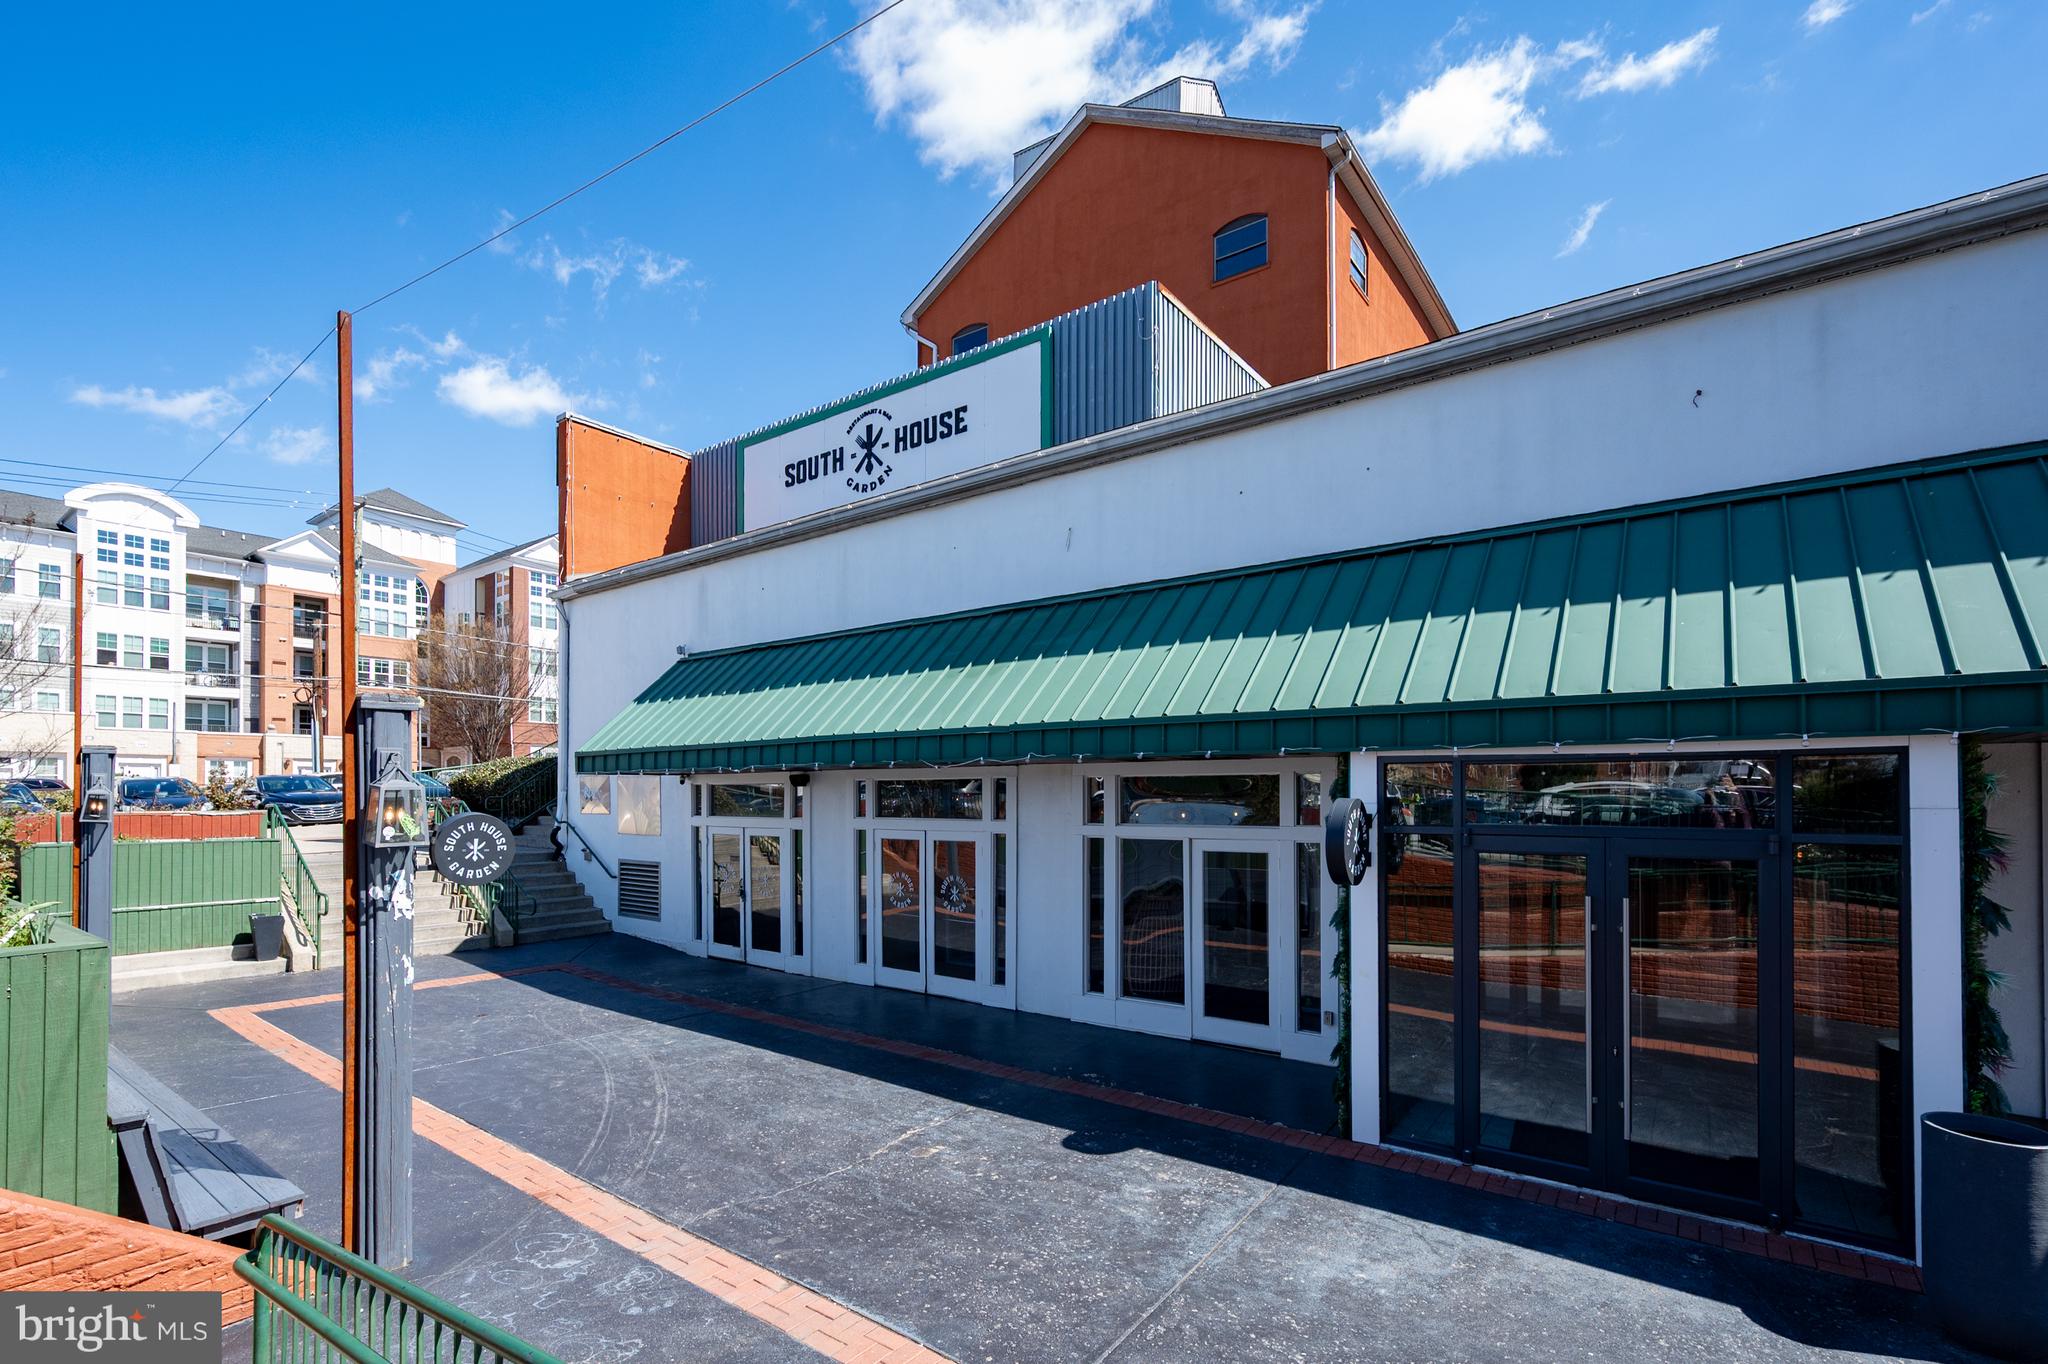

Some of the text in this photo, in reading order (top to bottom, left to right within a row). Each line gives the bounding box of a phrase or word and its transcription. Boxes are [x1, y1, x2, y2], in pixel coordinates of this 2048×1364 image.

[784, 404, 968, 488] SOUTH HOUSE
[846, 464, 893, 493] GARDEN
[443, 821, 507, 852] SOUTH HOUSE
[448, 860, 500, 879] GARDEN
